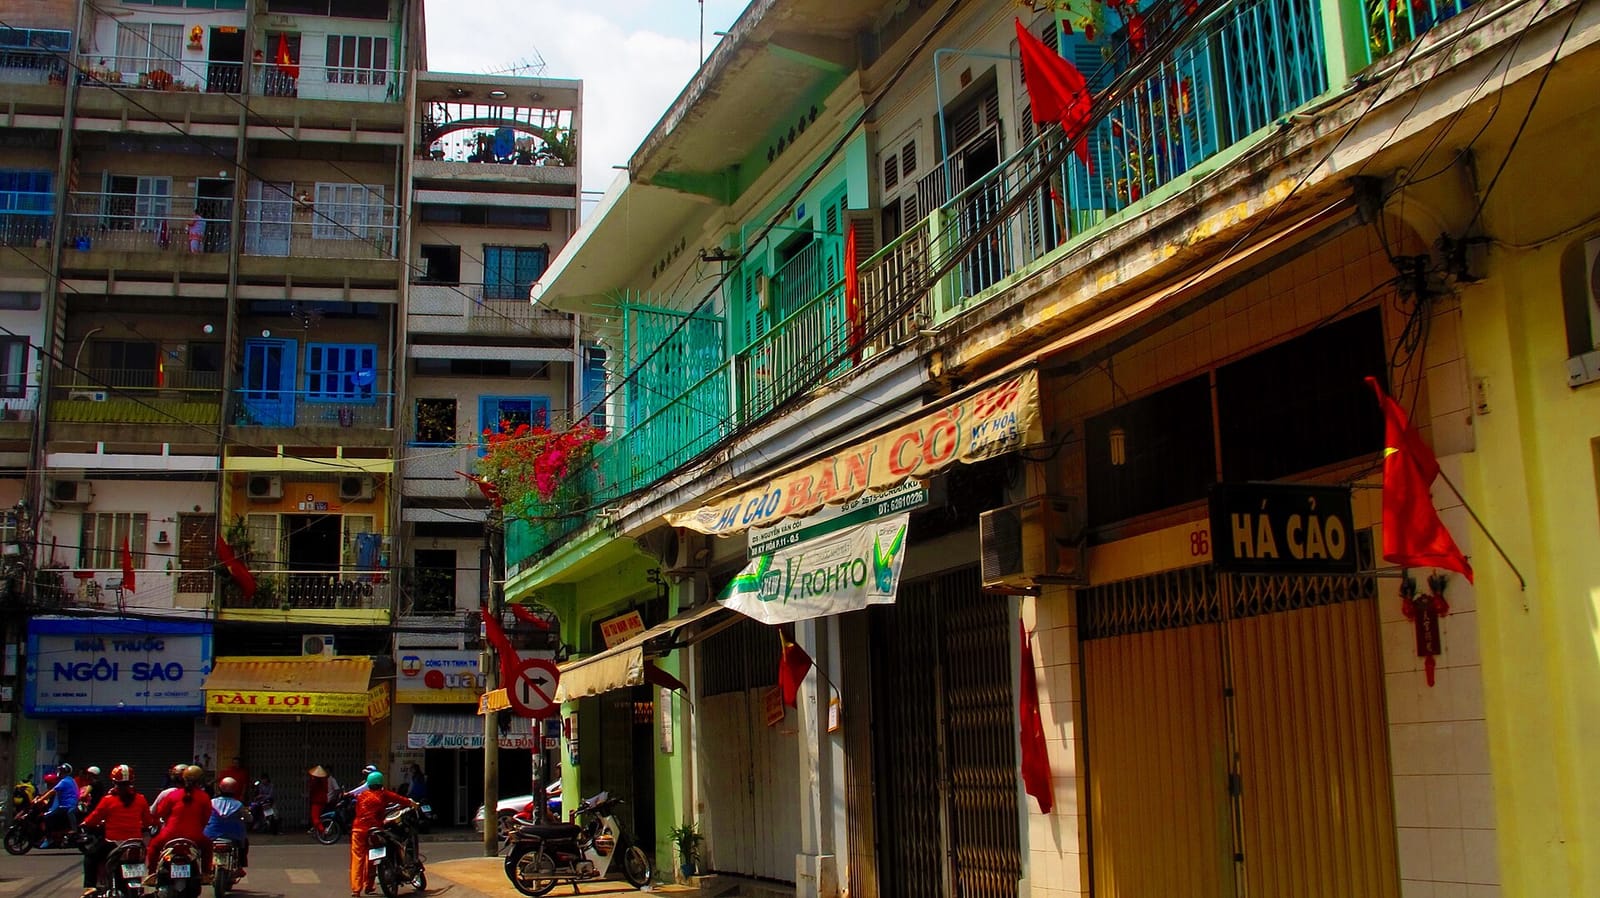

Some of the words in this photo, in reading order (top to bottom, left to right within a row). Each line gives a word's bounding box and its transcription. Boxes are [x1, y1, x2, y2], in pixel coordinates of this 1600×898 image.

[1231, 499, 1280, 558] HÁ
[1286, 496, 1345, 560] CẢO
[1190, 530, 1209, 556] 86
[74, 638, 105, 652] NHÀ
[53, 657, 119, 681] NGÔI
[132, 662, 184, 681] SAO
[212, 692, 258, 705] TÀI
[268, 694, 311, 708] LỢI
[444, 734, 468, 746] NƯỚC
